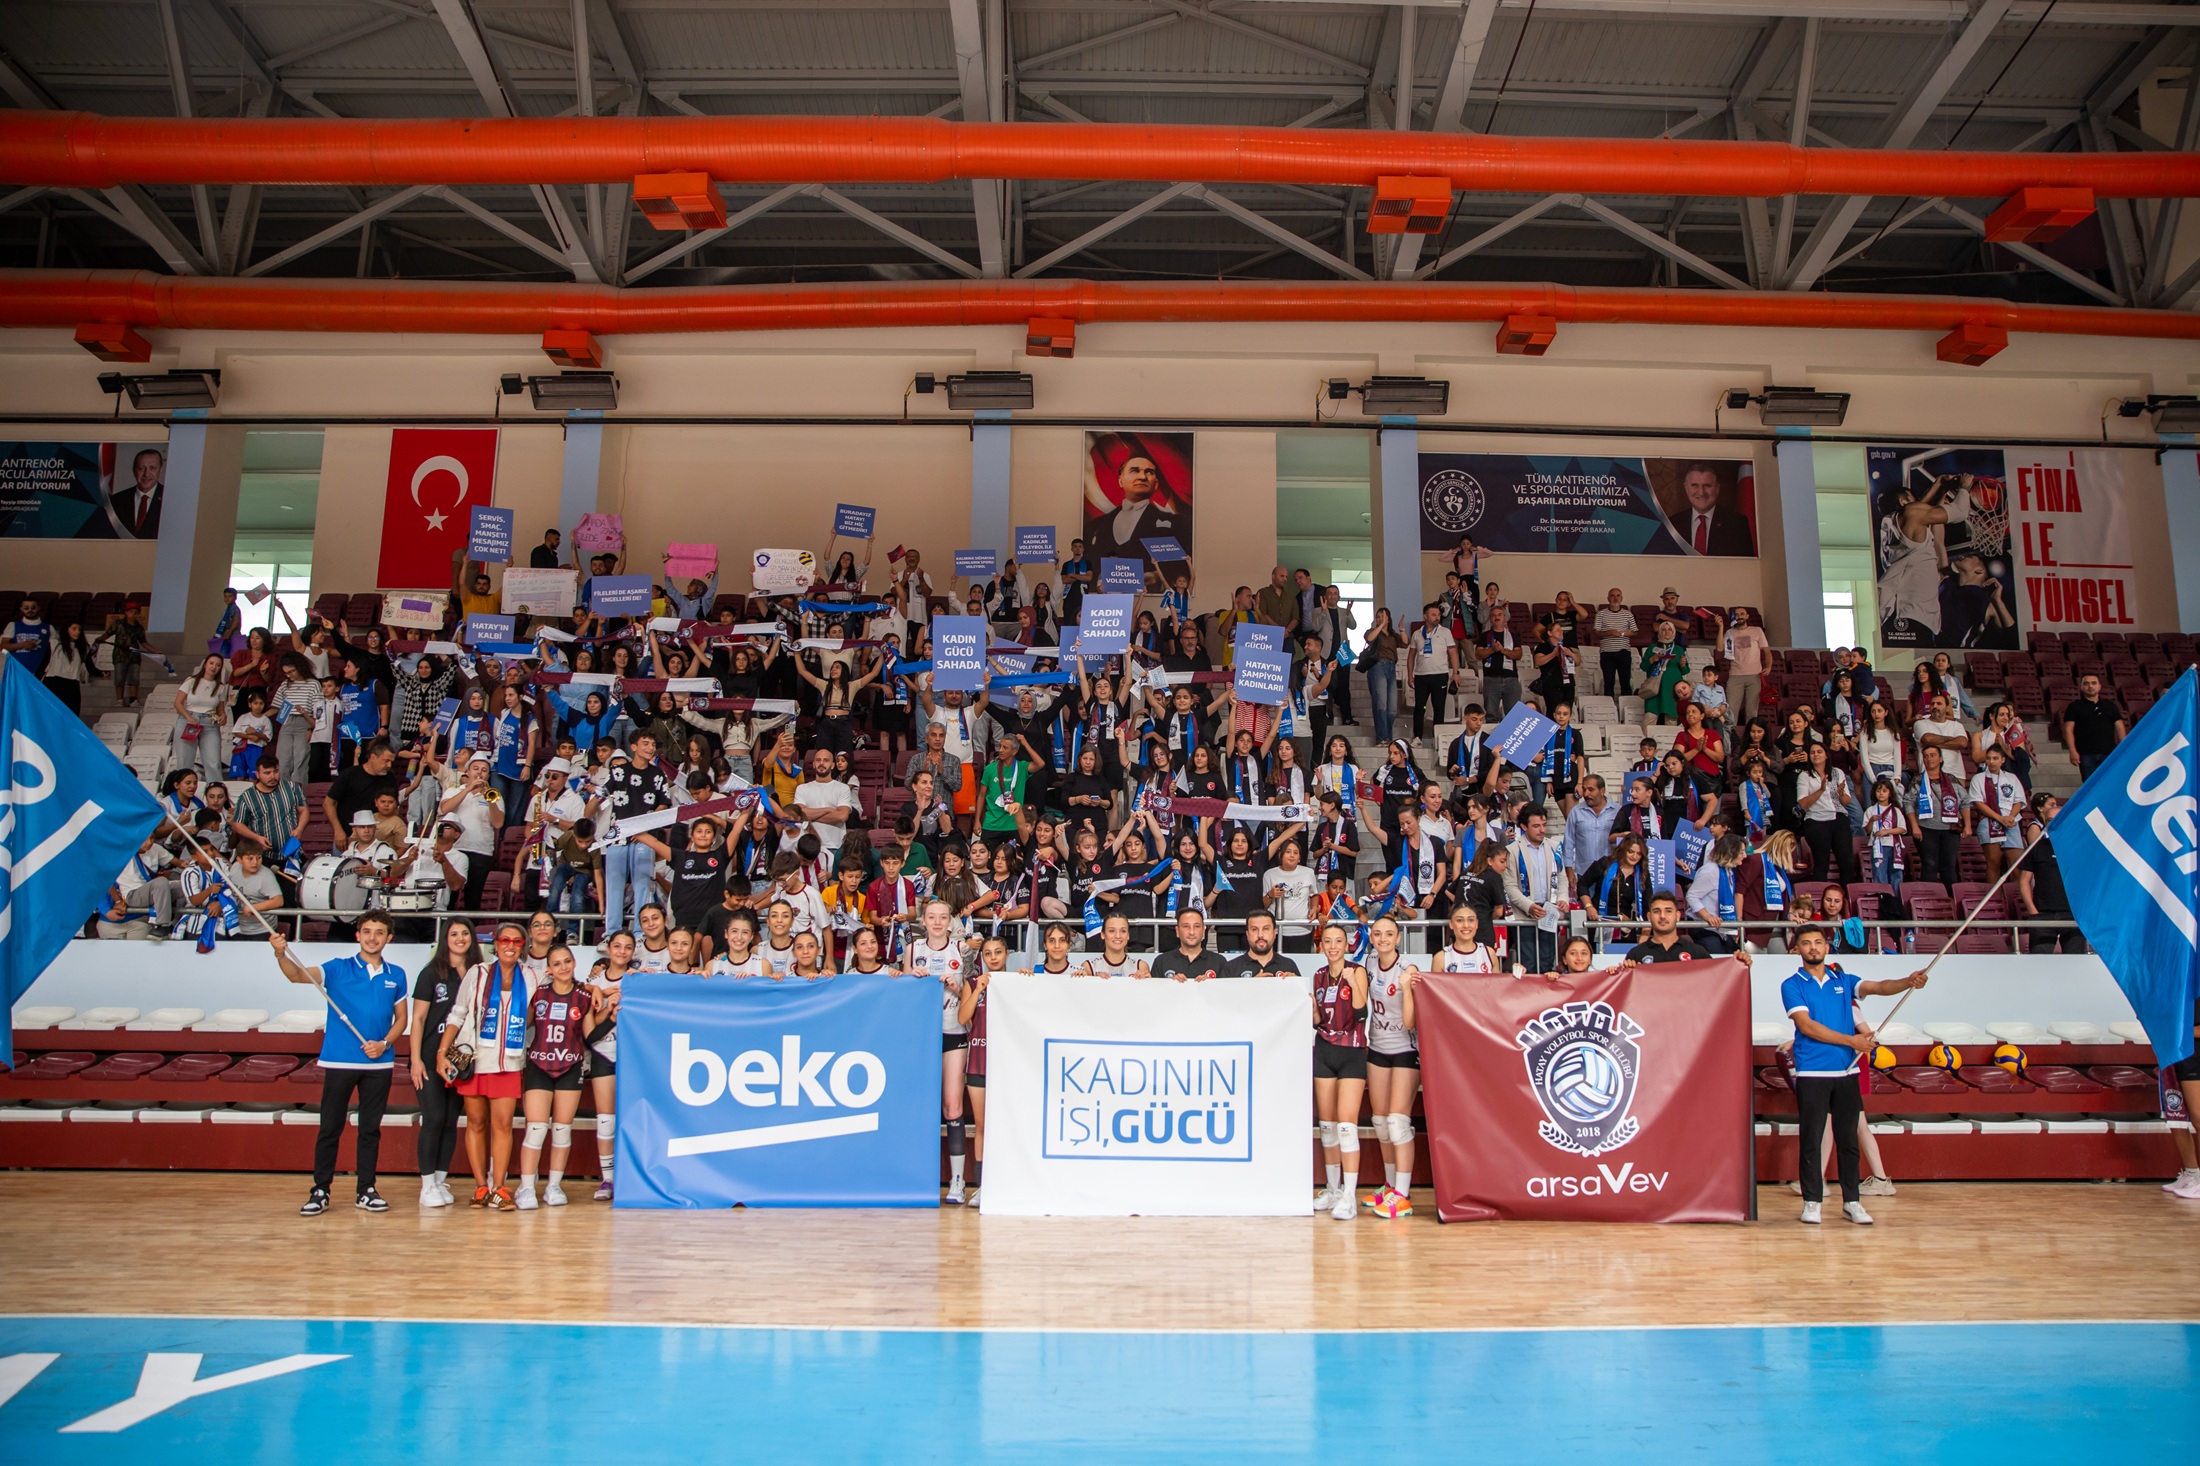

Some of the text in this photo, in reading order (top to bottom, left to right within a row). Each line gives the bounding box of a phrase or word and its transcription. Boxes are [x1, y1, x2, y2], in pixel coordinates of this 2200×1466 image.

[1, 458, 64, 469] ANTRENÖR
[1525, 473, 1617, 486] TÜM ANTRENÖR
[16, 481, 70, 490] DİLİYORUM
[1513, 485, 1630, 496] VE SPORCULARIMIZA
[1517, 497, 1627, 506] BAŞARILAR DİLİYORUM
[478, 513, 506, 523] SERVİS,
[480, 522, 503, 531] SMAÇ,
[475, 530, 508, 539] MANŞET!
[472, 537, 509, 547] MESAJIMIZ
[474, 546, 507, 555] ÇOK NET!
[1115, 564, 1130, 572] İŞİM
[593, 589, 618, 597] FİLELERİ
[2025, 573, 2134, 625] YÜKSEL
[1090, 609, 1123, 617] KADIN
[472, 622, 509, 631] HATAY'IN
[1091, 618, 1120, 627] GÜCÜ
[477, 631, 502, 640] KALBİ
[942, 634, 977, 644] KADIN
[1083, 629, 1126, 638] SAHADA
[1251, 632, 1268, 643] İŞİM
[944, 646, 974, 657] GÜCÜ
[1244, 641, 1273, 651] GÜCÜM
[936, 660, 981, 670] SAHADA
[997, 654, 1027, 670] KADIN
[1245, 660, 1282, 672] HATAY'IN
[1241, 669, 1283, 682] ŞAMPİYON
[1238, 679, 1284, 692] KADINLARI!
[1503, 717, 1533, 749] GÜÇ BİZİM,
[1507, 717, 1541, 755] UMUT BİZİM
[1680, 831, 1692, 841] ÖN
[1657, 853, 1665, 885] SETLER
[1334, 899, 1350, 920] beko
[1325, 1007, 1334, 1024] 7
[545, 1024, 566, 1043] 16
[530, 1048, 580, 1062] arsaVev
[1535, 1030, 1635, 1086] HATAY VOLEYBOL SPOR KULÜBÜ
[670, 1033, 887, 1109] beko
[1061, 1056, 1236, 1096] KADININ
[1576, 1126, 1601, 1138] 2018
[1526, 1162, 1669, 1198] arsaVev
